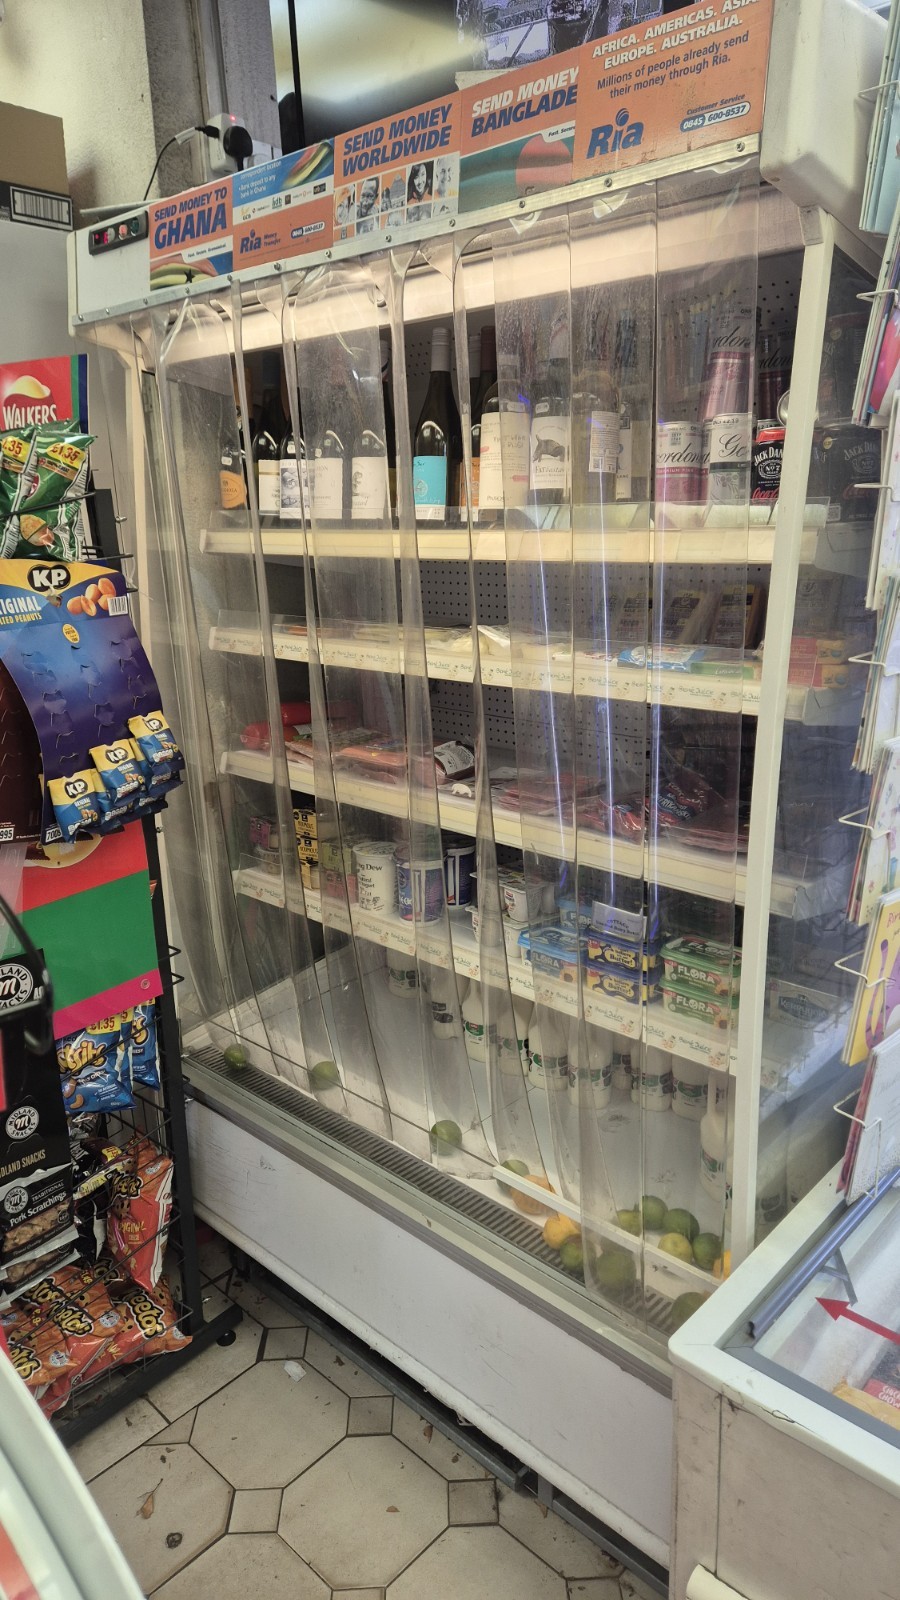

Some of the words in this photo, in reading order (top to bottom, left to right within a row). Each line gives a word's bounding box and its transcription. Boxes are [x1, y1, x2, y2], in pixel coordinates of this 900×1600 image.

[592, 33, 640, 58] AFRICA.
[644, 6, 717, 40] AMERICAS.
[604, 46, 656, 70] EUROPE.
[661, 14, 743, 50] AUSTRALIA.
[597, 70, 632, 90] Millions
[635, 65, 645, 78] of
[648, 55, 680, 77] people
[683, 41, 721, 62] already
[724, 30, 749, 49] send
[610, 82, 631, 99] their
[634, 73, 666, 92] money
[669, 61, 709, 82] through
[712, 54, 731, 68] Ria.
[472, 88, 513, 118] SEND
[517, 66, 580, 102] MONEY
[686, 101, 718, 116] Customer
[720, 93, 745, 106] Service
[471, 84, 578, 137] BANGLADE
[683, 115, 704, 130] 0845
[708, 104, 747, 122] 600-8537
[343, 126, 384, 156] SEND
[388, 103, 453, 141] MONEY
[586, 107, 644, 159] Ria
[342, 124, 453, 177] WORLDWIDE
[154, 204, 177, 222] SEND
[179, 191, 213, 214] MONEY
[214, 186, 228, 201] TO
[154, 203, 228, 250] GHANA
[239, 228, 262, 254] Ria
[2, 404, 58, 431] WALKERS
[51, 443, 81, 462] £1.35
[754, 450, 769, 467] JACK
[32, 568, 67, 588] KP
[0, 596, 42, 615] IGINAL
[15, 612, 43, 623] PEANUTS
[106, 748, 127, 762] KP
[66, 781, 86, 796] KP
[677, 965, 716, 984] FLORA
[675, 995, 714, 1014] FLORA
[8, 1108, 36, 1127] MIDLAND
[11, 1122, 36, 1137] SNACKS
[22, 1149, 46, 1168] SNACKS
[32, 1182, 64, 1201] TRADITIONAL
[9, 1212, 27, 1227] Pork
[27, 1190, 67, 1217] Scratchings
